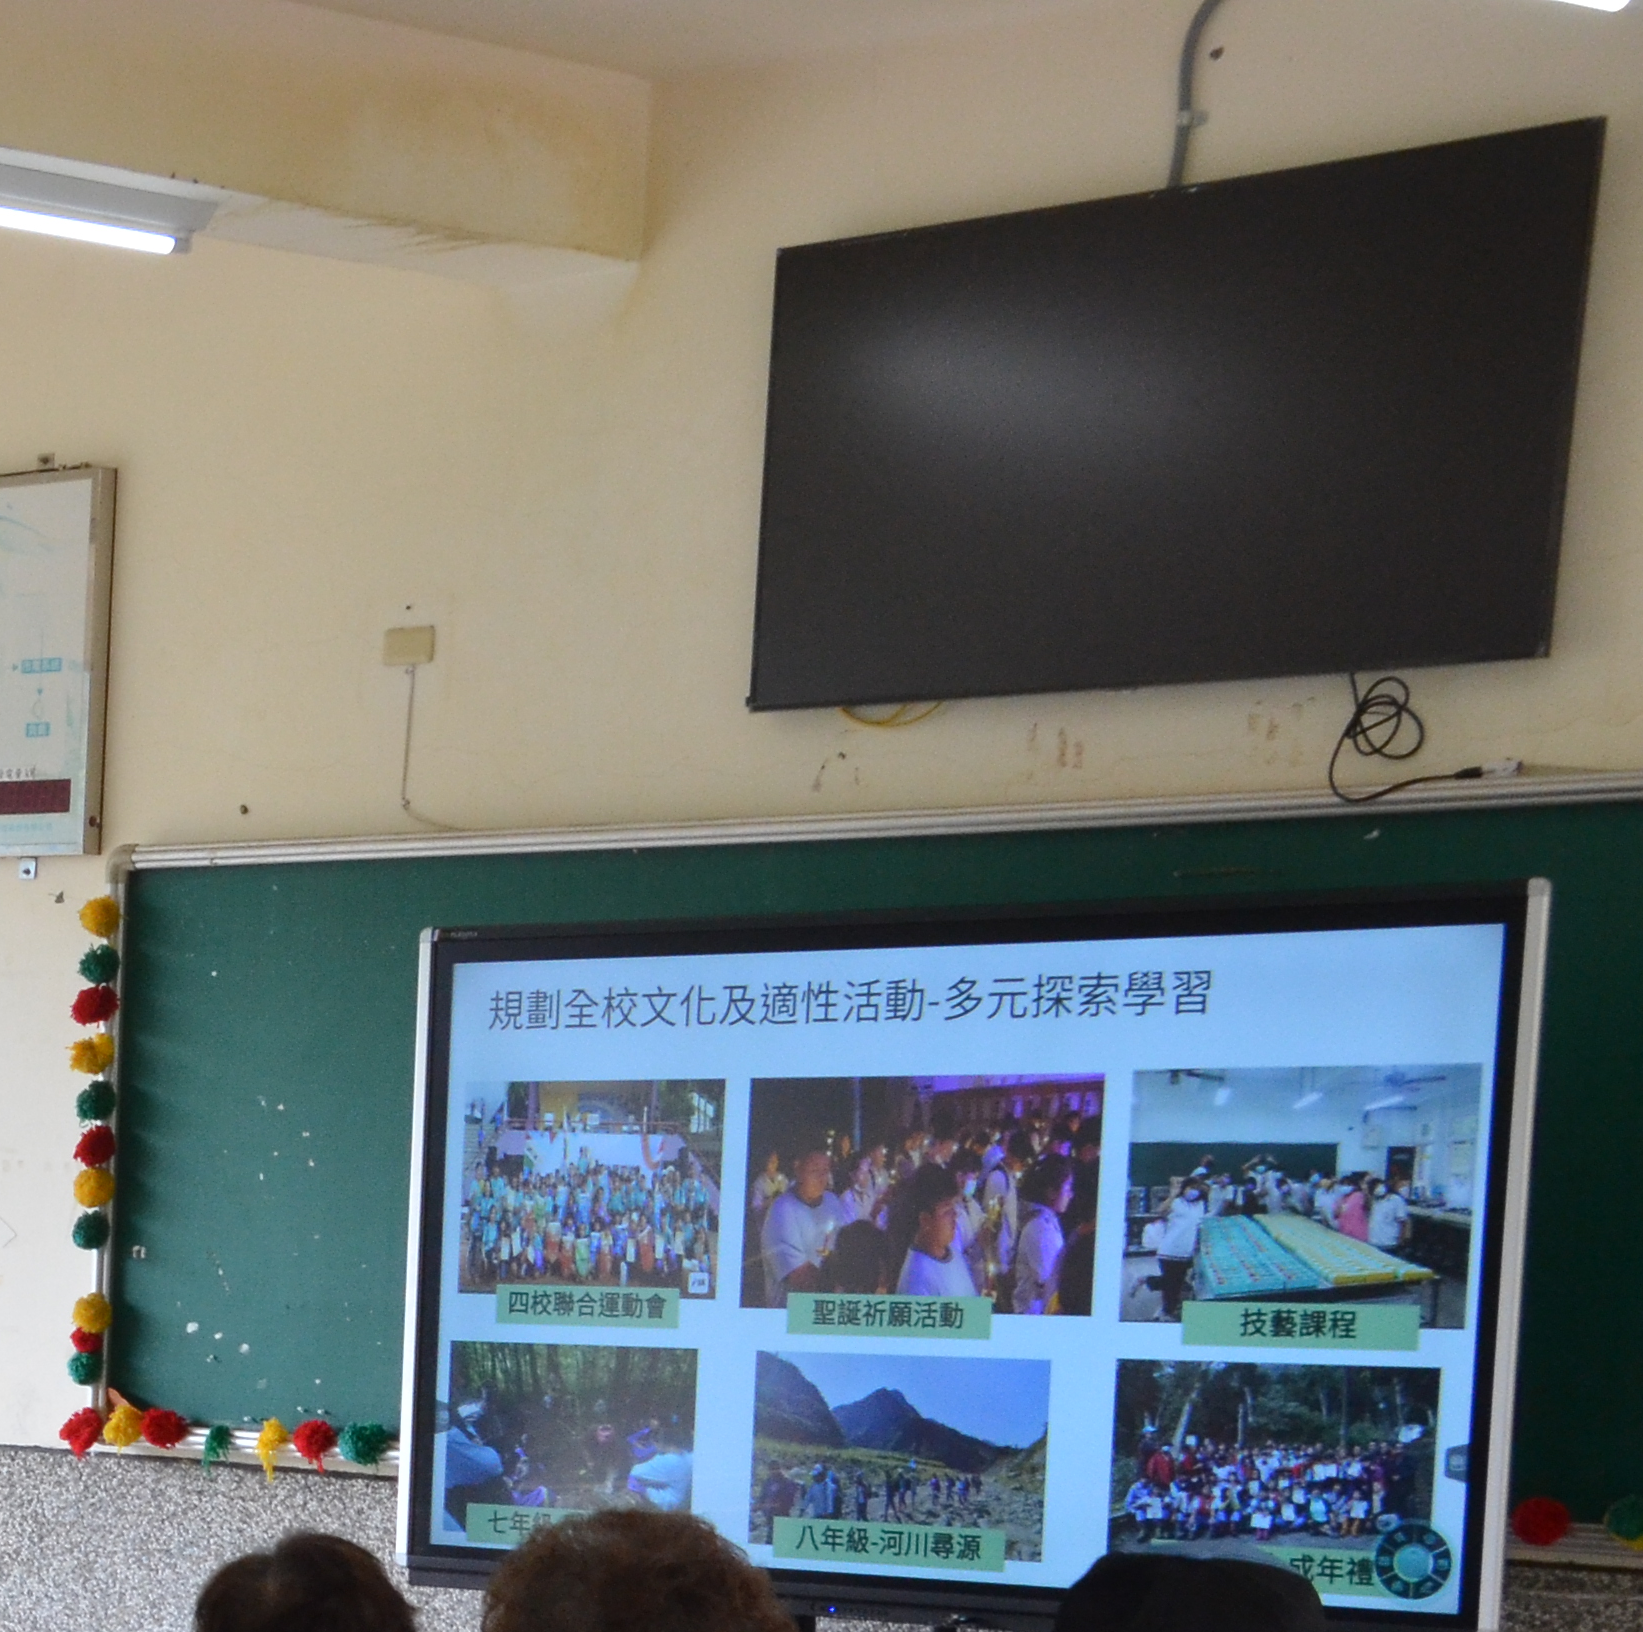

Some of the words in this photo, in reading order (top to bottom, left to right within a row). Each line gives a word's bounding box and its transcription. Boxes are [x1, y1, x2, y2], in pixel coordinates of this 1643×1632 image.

[488, 970, 1214, 1031] 規劃全校文化及適性活動-多元探索學習
[508, 1290, 668, 1319] 四校聯合運動會
[812, 1299, 964, 1330] 聖誕祈願活動
[1240, 1308, 1357, 1339] 技藝課程
[796, 1525, 982, 1561] 八年級-河川尋源
